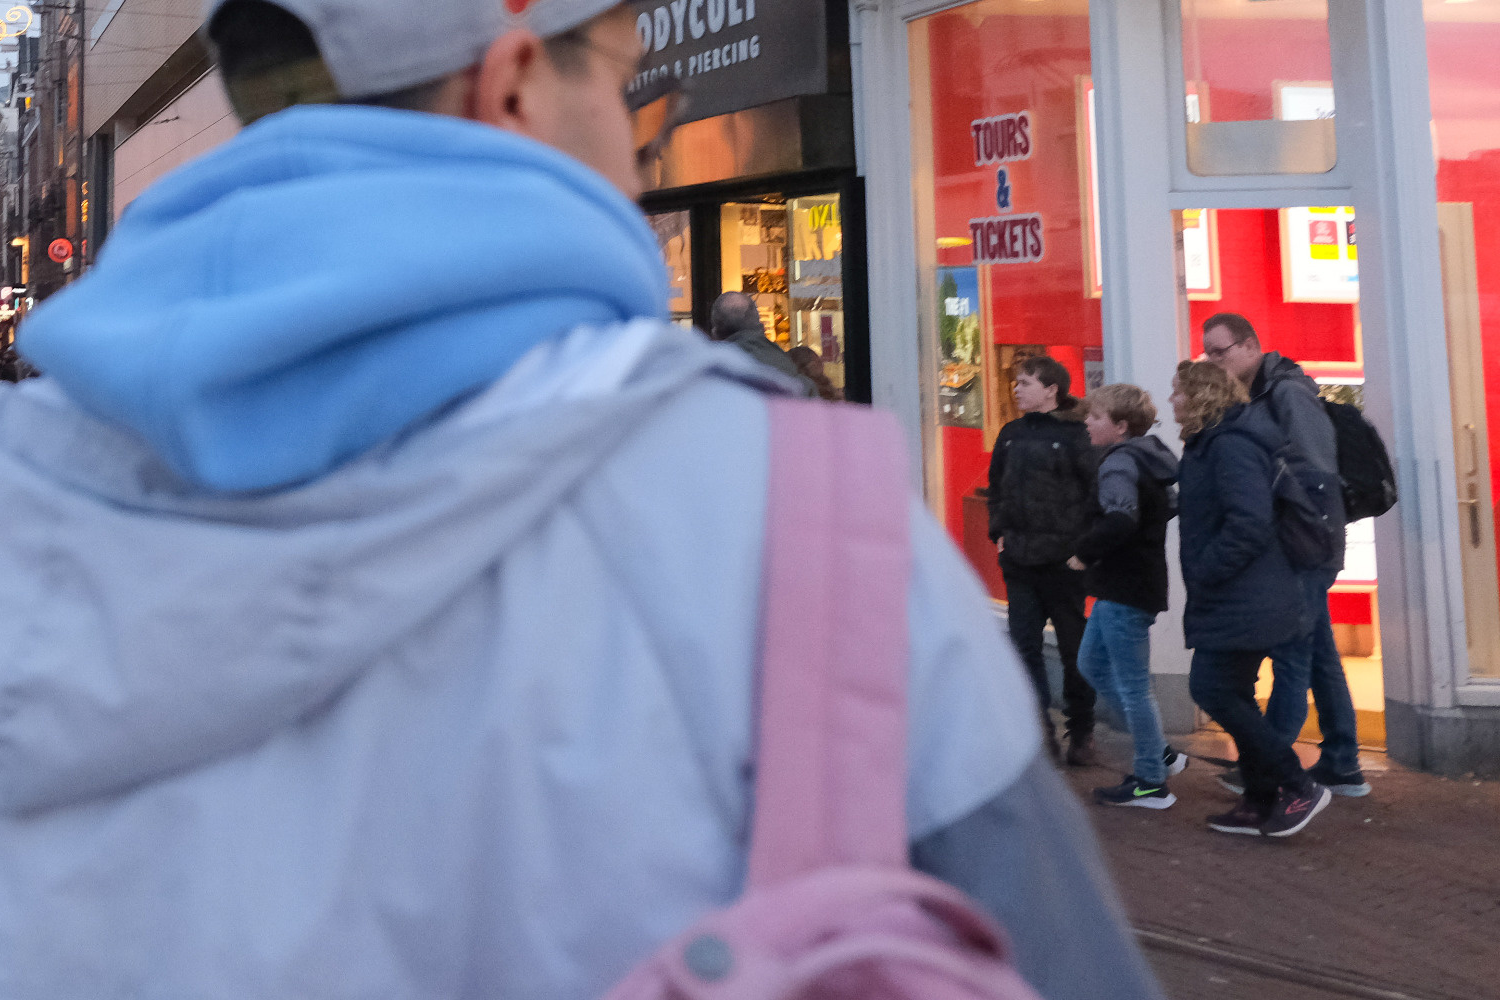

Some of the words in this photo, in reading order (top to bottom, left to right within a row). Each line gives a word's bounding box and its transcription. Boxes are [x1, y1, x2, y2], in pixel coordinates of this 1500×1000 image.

[689, 35, 760, 77] PIERCING
[971, 113, 1032, 166] TOURS
[996, 169, 1011, 209] &
[970, 215, 1043, 263] TICKETS
